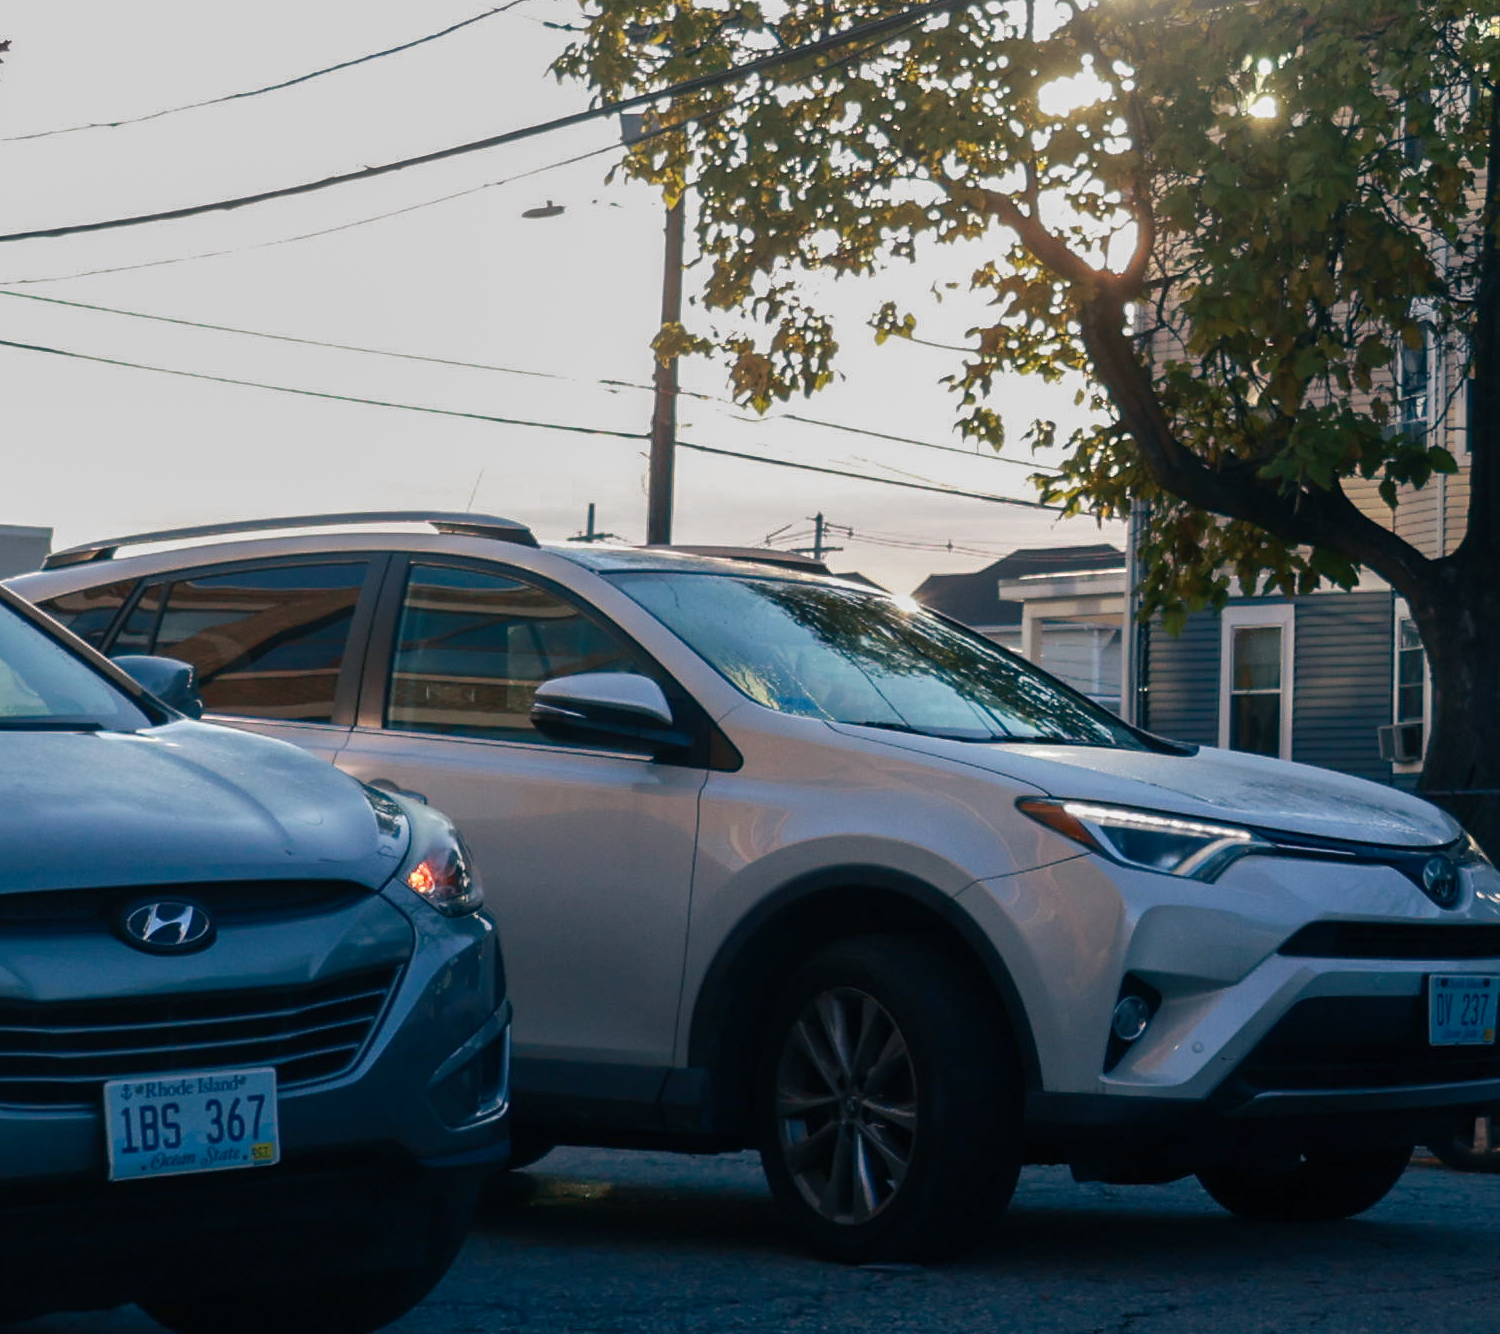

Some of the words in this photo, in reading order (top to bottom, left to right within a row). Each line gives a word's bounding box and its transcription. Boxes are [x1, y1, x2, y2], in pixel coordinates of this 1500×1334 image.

[1461, 993, 1489, 1026] 237
[145, 1079, 194, 1098] Rhode
[197, 1075, 239, 1093] Island
[121, 1102, 182, 1154] 1BS
[204, 1094, 266, 1144] 367
[150, 1151, 196, 1170] Ocean
[199, 1146, 240, 1166] State
